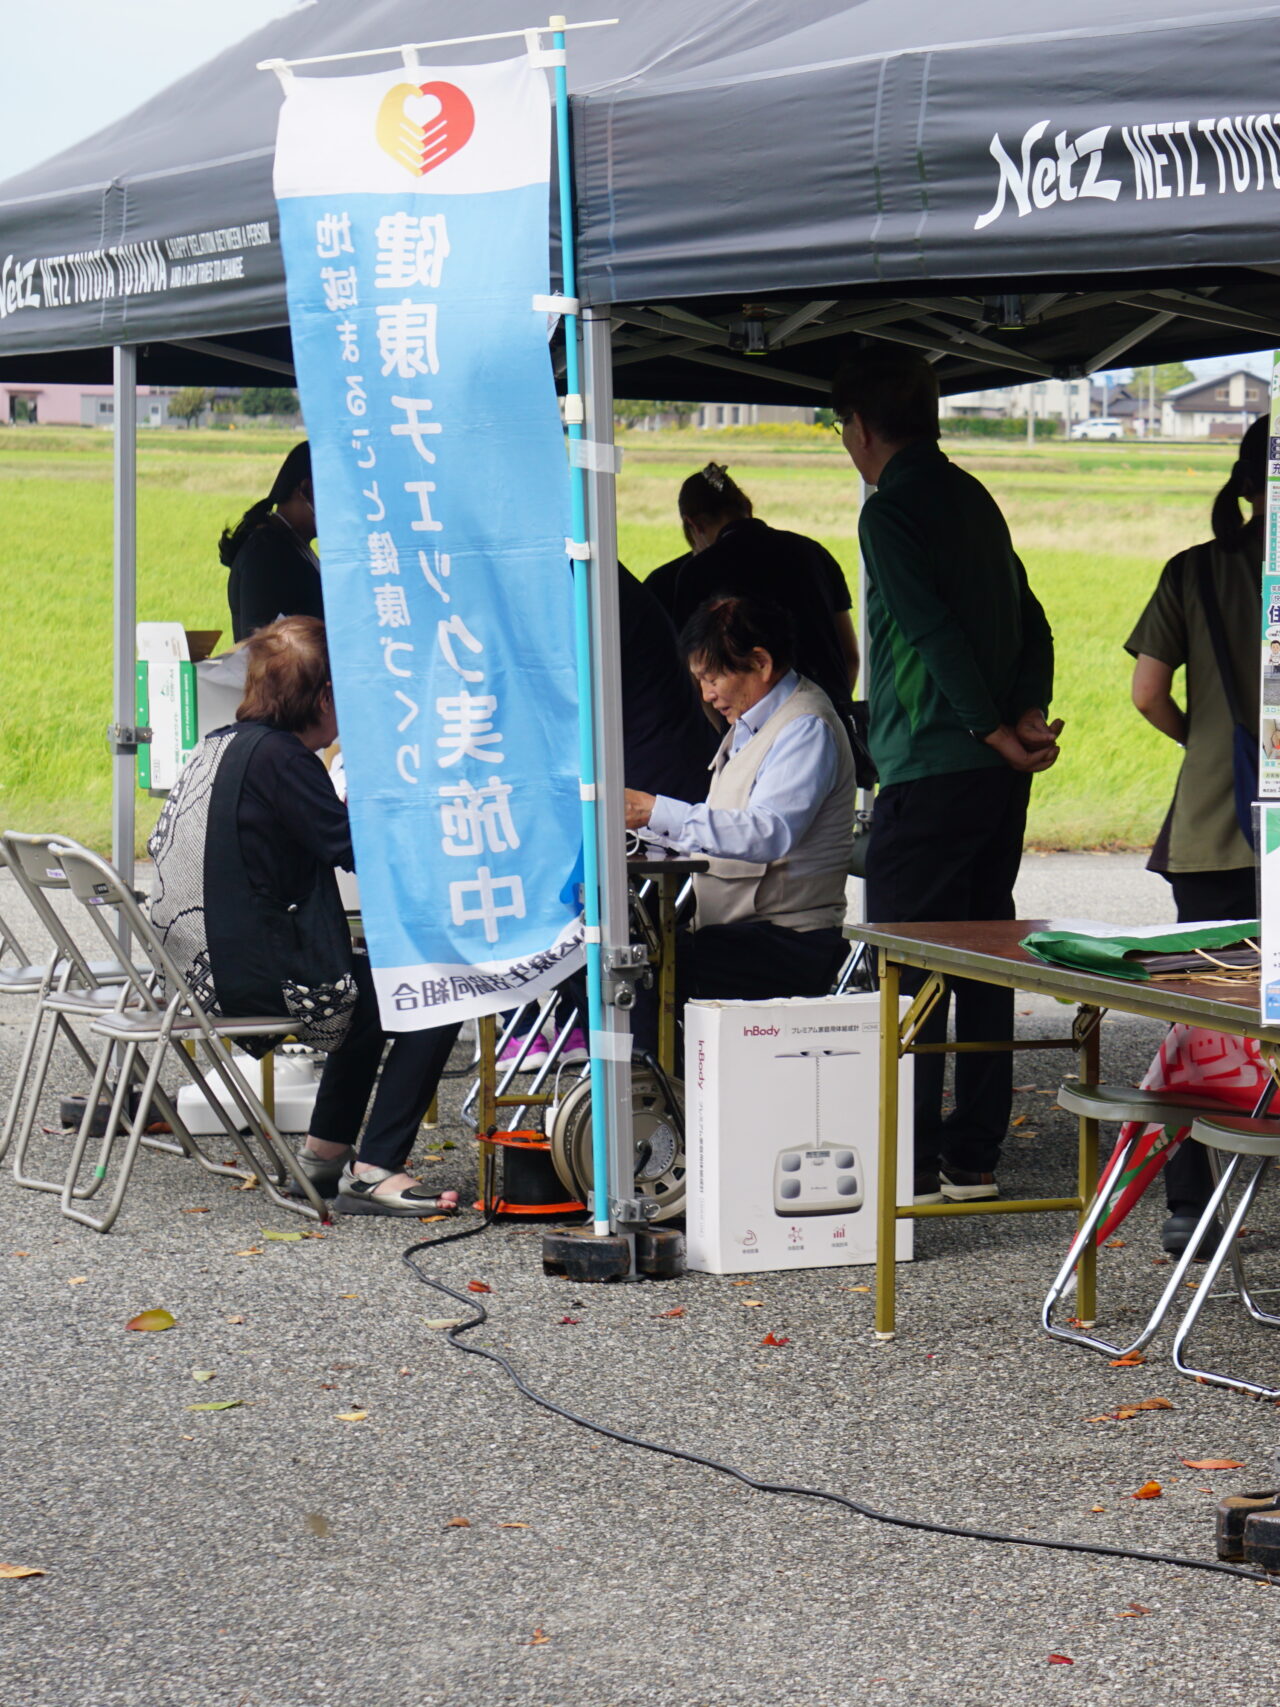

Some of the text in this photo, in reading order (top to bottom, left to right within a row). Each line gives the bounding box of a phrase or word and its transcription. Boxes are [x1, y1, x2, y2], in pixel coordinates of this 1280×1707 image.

[974, 119, 1122, 230] Netz
[1121, 120, 1206, 200] NETZ
[169, 237, 191, 260] HAPPY
[188, 231, 218, 256] RELATION
[214, 227, 243, 251] BETWEEN
[246, 221, 271, 246] PERSON
[40, 256, 71, 307] NETZ
[67, 249, 115, 303] TOYOTA
[109, 240, 167, 296] TOYAMA
[170, 266, 181, 288] AND
[187, 264, 198, 286] CAR
[198, 261, 213, 284] TRIES
[213, 260, 221, 281] TO
[743, 1025, 780, 1037] InBody
